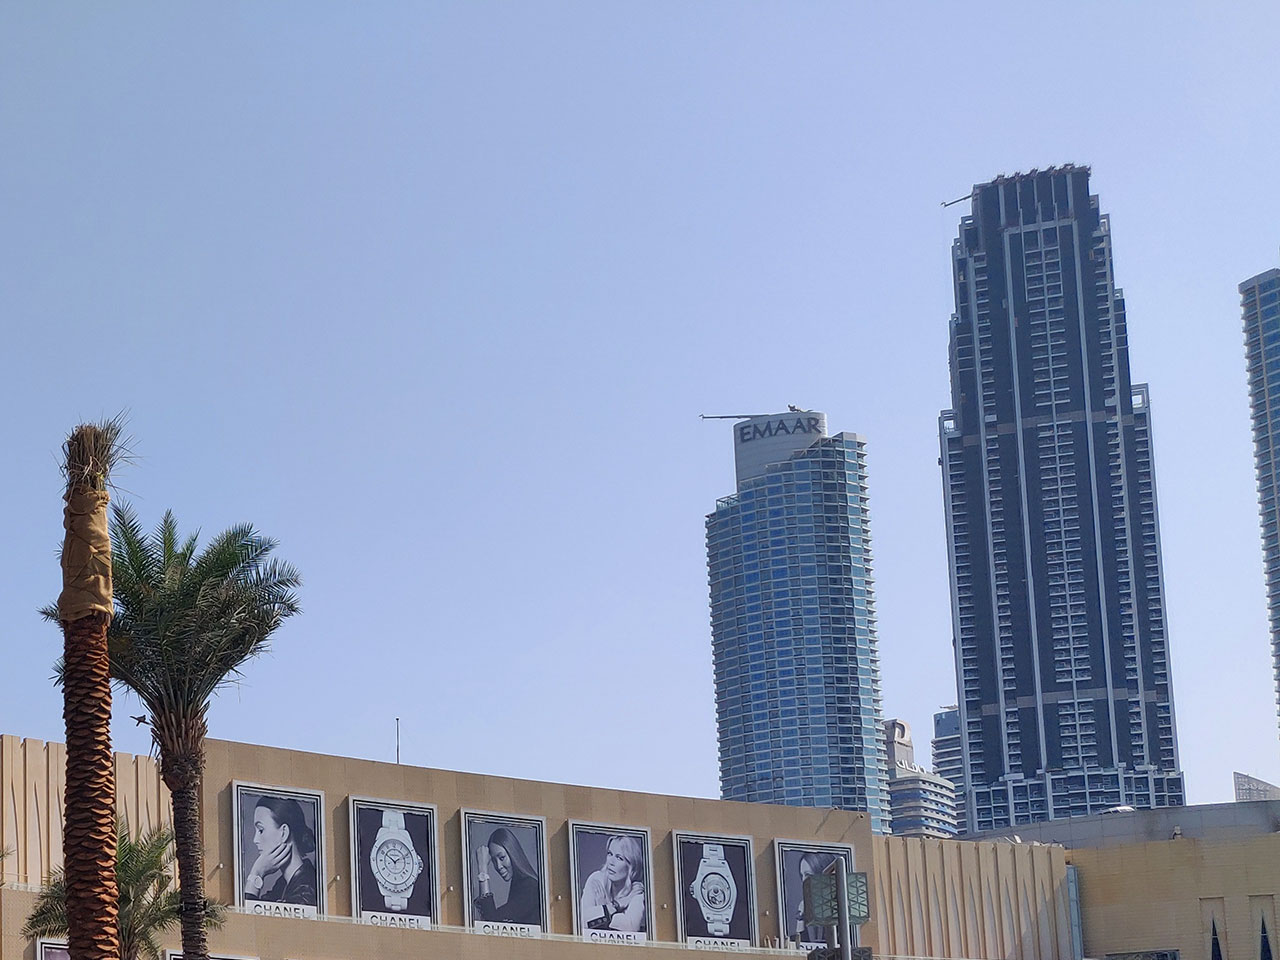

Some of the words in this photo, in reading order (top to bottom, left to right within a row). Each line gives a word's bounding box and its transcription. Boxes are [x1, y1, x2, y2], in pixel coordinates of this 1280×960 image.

[740, 417, 822, 442] EMAAR
[254, 904, 310, 919] CHANEL
[371, 914, 424, 929] CHANEL
[483, 924, 534, 938] CHANEL
